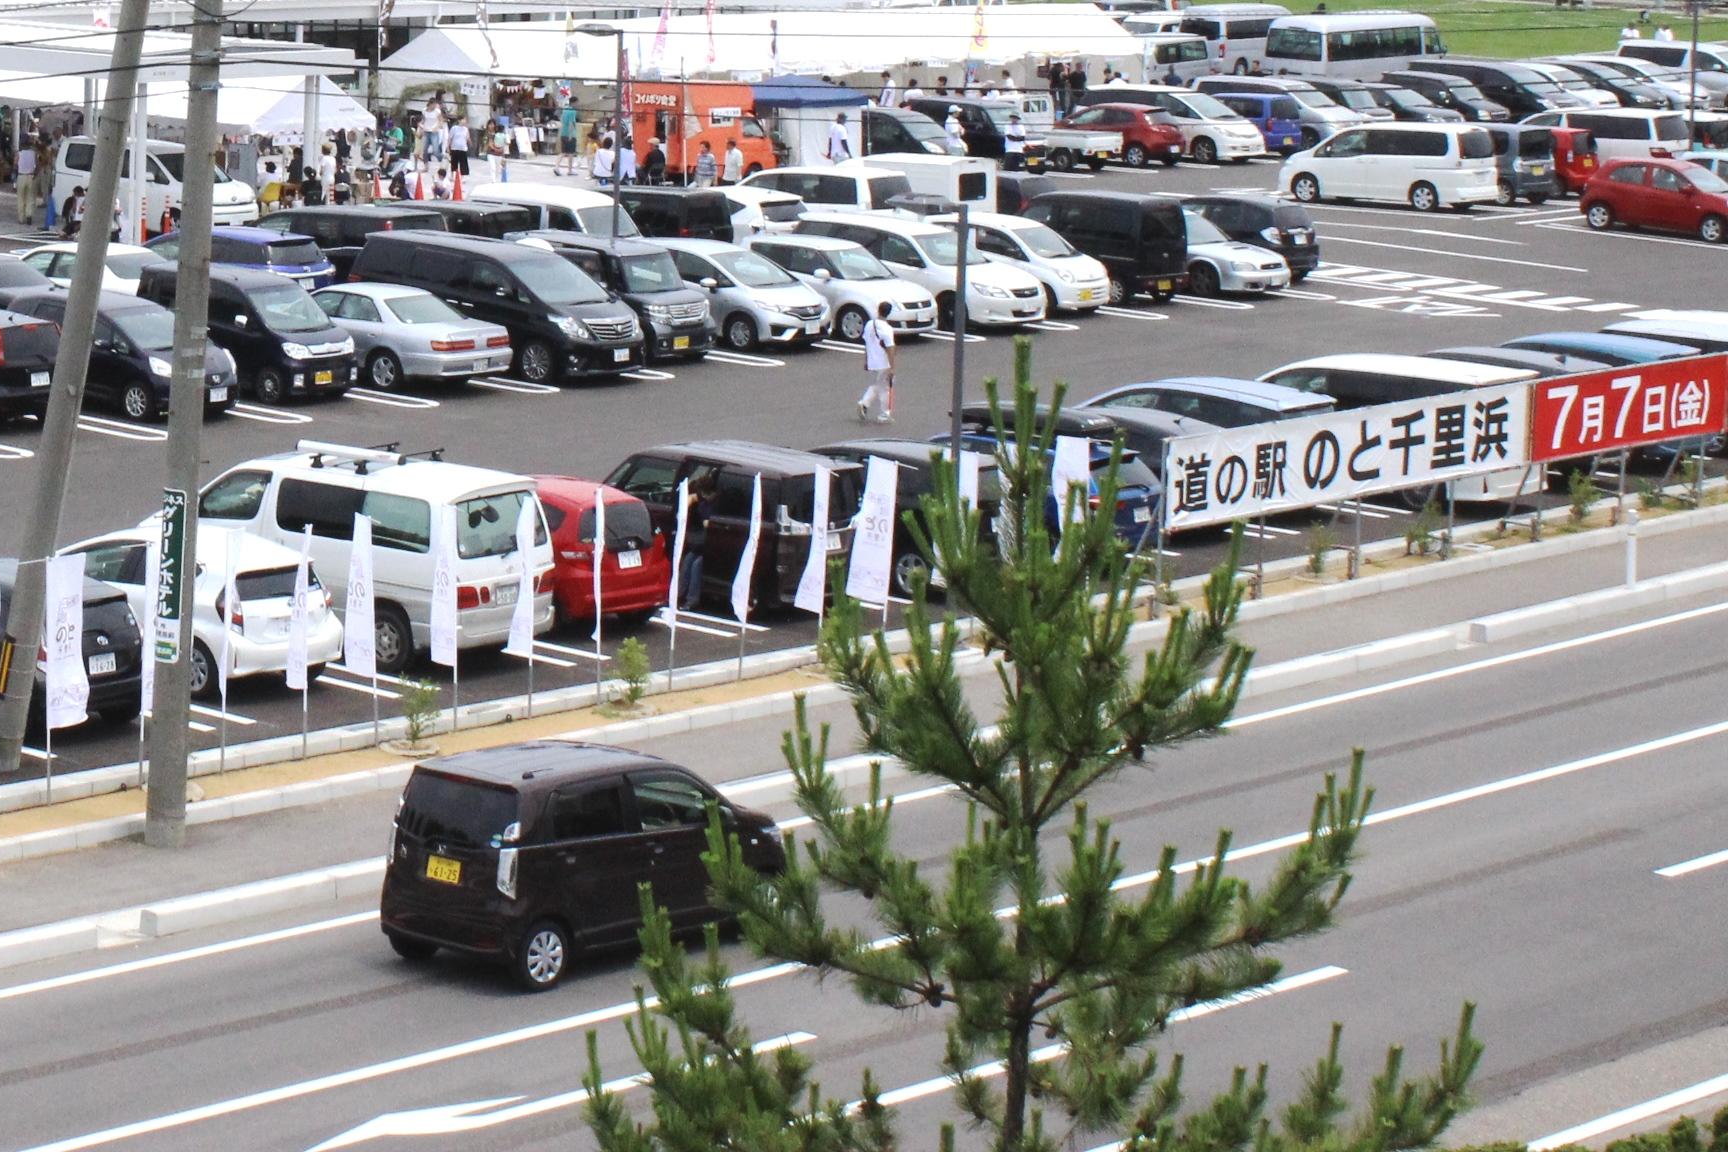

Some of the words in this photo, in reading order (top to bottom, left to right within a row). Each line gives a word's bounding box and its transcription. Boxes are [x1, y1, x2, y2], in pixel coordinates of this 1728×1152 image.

[1173, 440, 1287, 514] 道の駅
[1303, 396, 1510, 489] のと千里浜
[1546, 374, 1711, 450] 7月7日(金)
